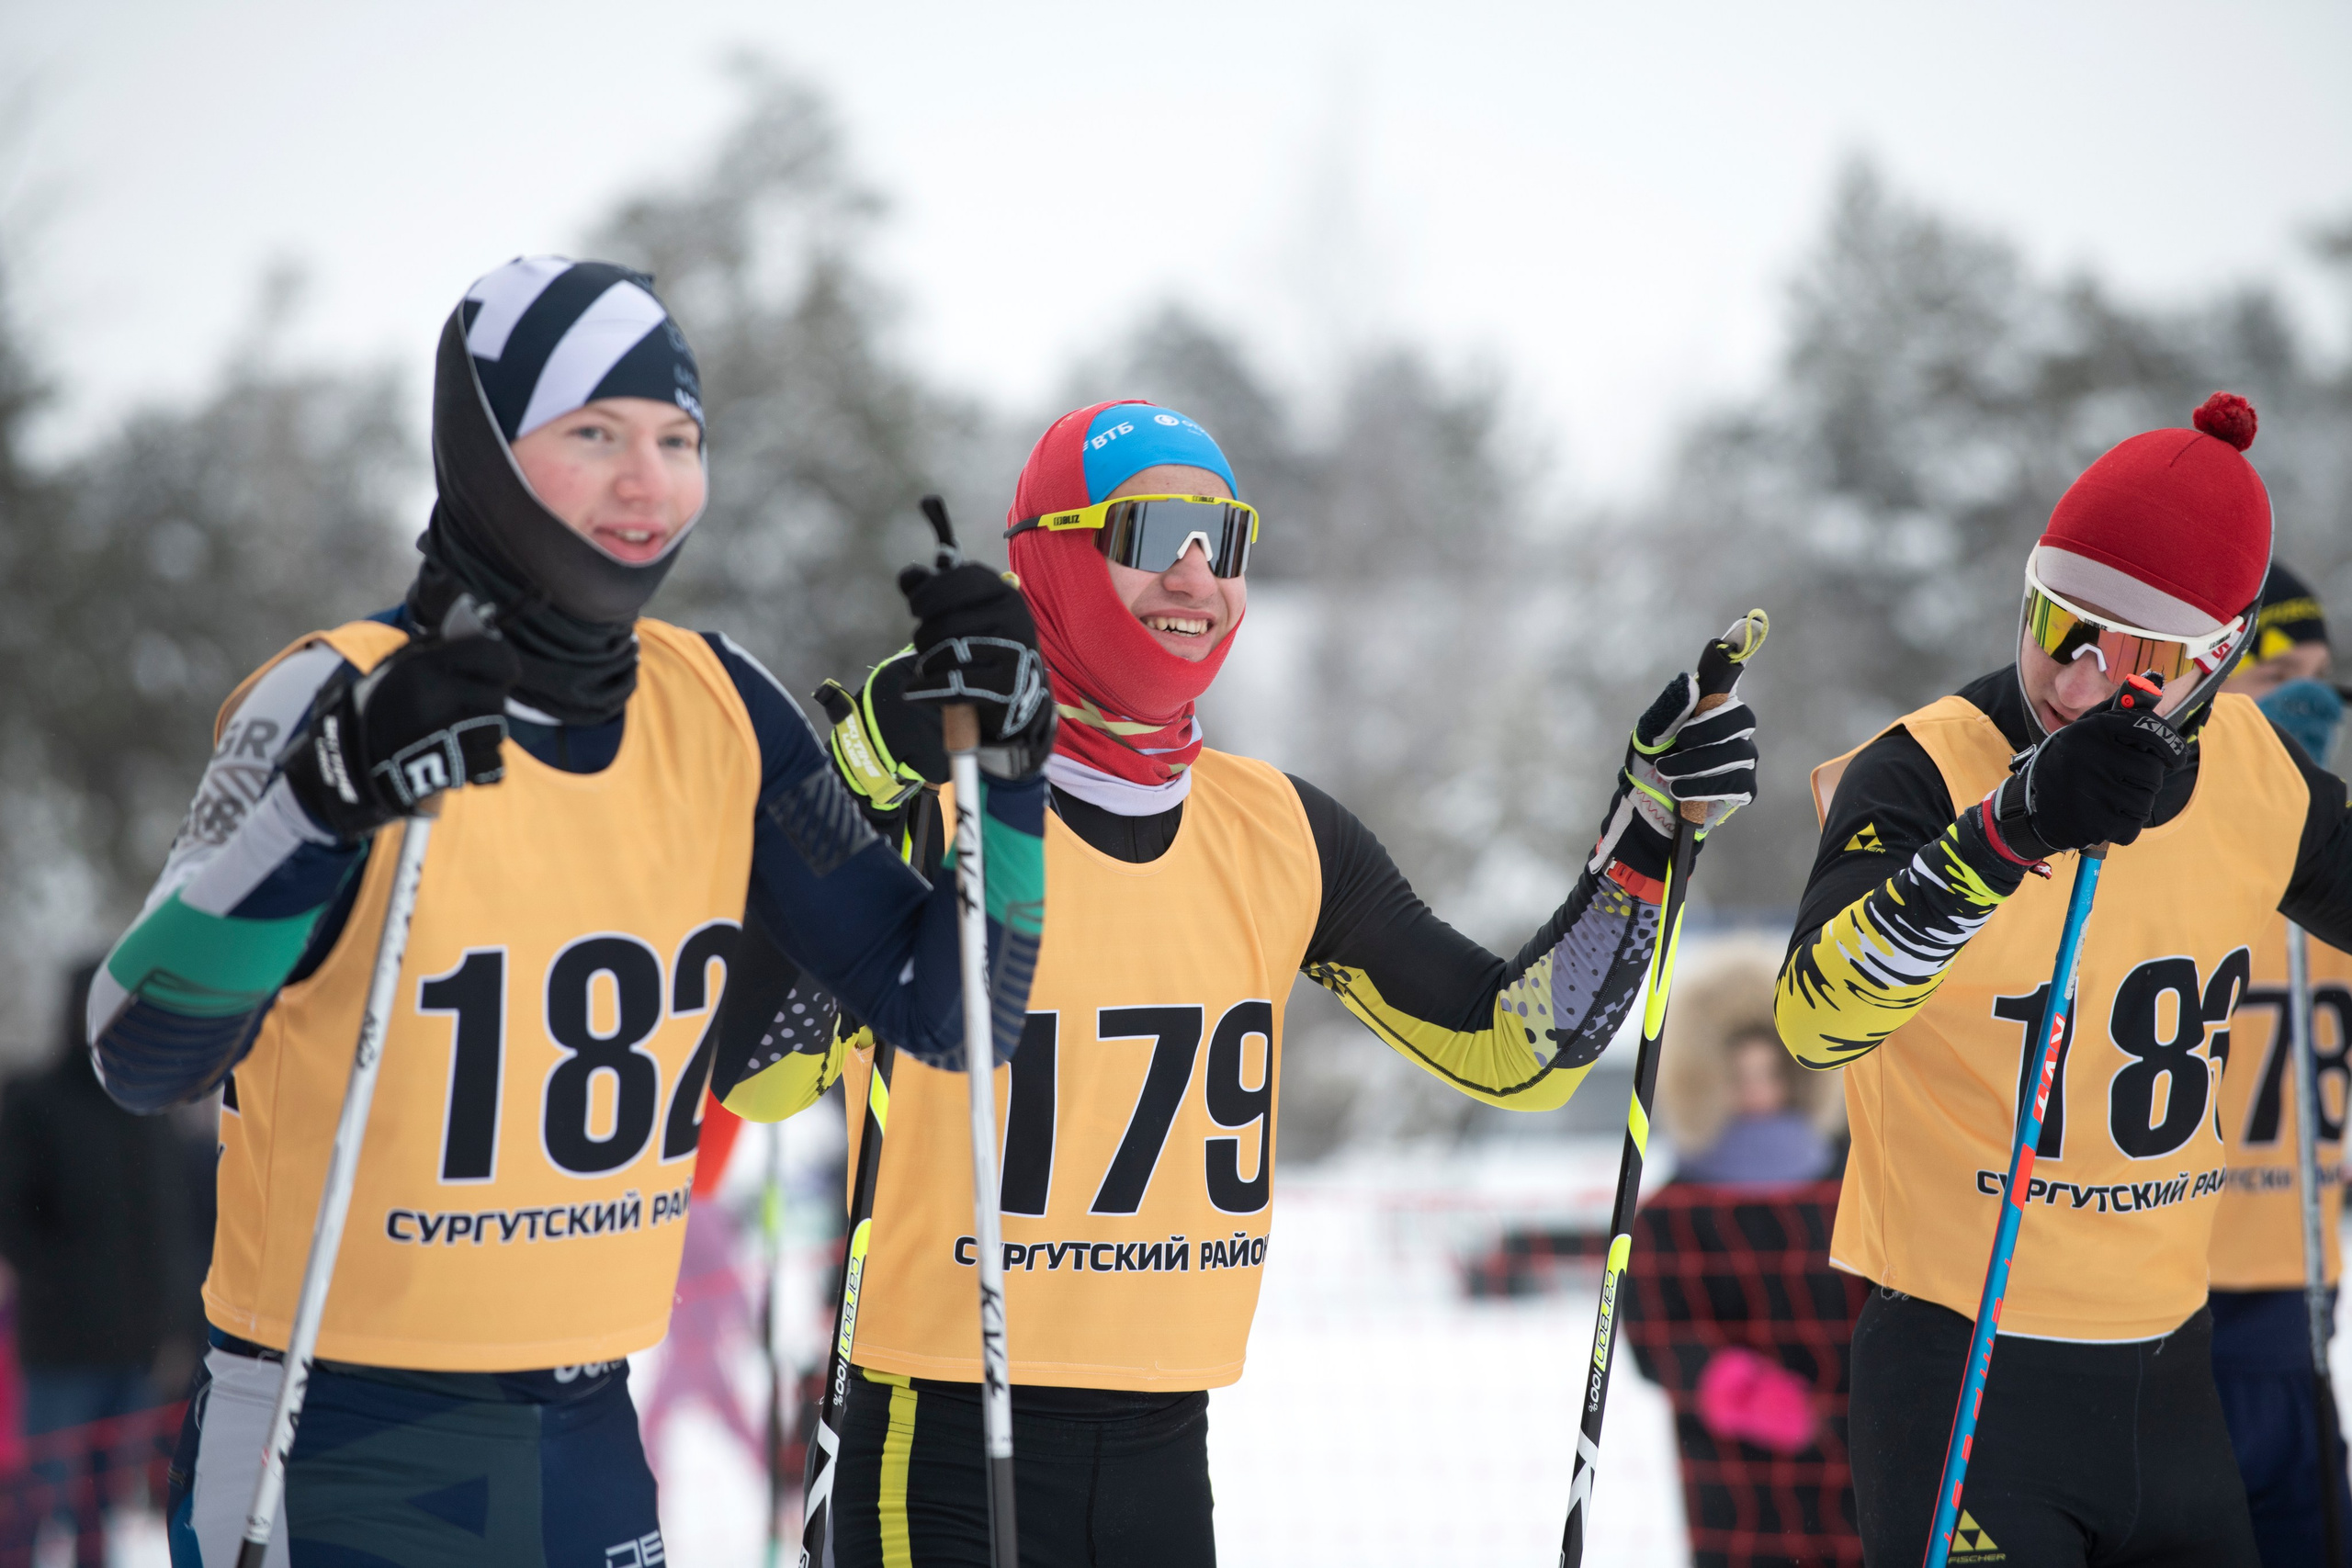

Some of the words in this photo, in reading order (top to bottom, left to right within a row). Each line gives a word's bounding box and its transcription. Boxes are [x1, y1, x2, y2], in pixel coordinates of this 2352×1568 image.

[1091, 421, 1134, 450] ВТБ
[2133, 716, 2185, 756] KV+
[415, 918, 742, 1185] 182
[1000, 998, 1272, 1217] 179
[386, 1190, 643, 1246] СУРГУТСКИЙ
[954, 1235, 1190, 1272] СРГУТСКИЙ
[1947, 1552, 2007, 1564] FISCHER
